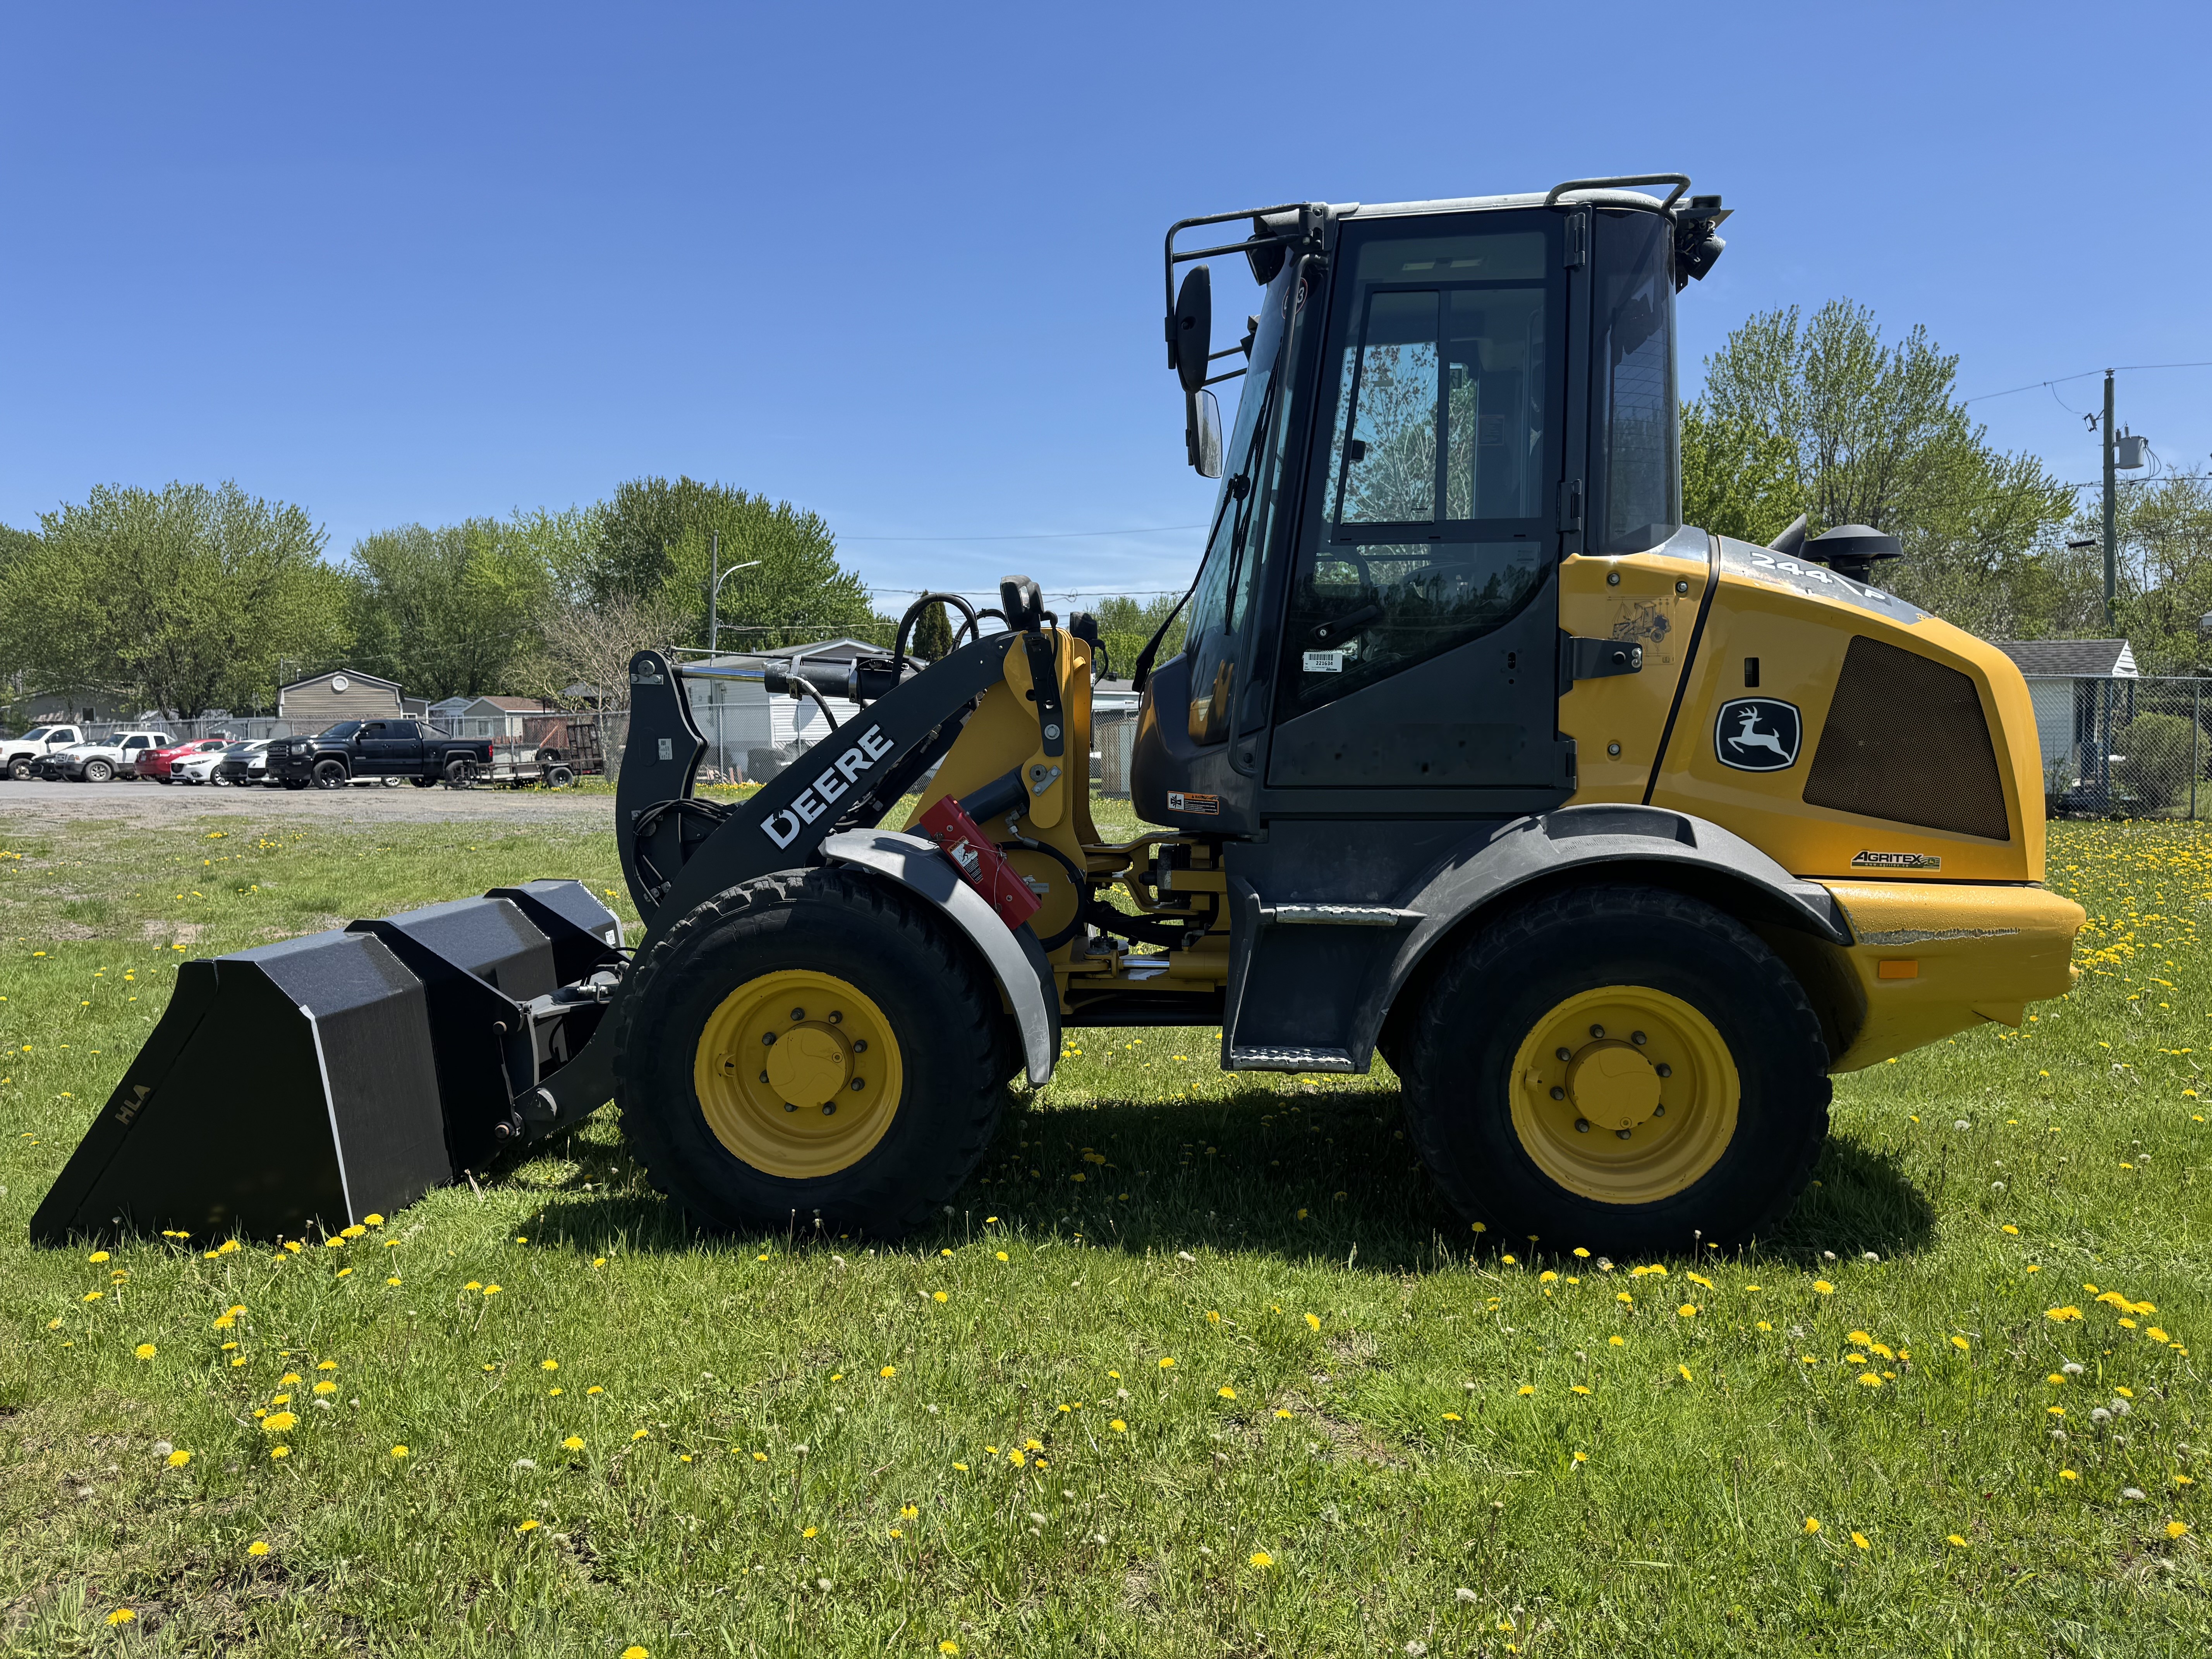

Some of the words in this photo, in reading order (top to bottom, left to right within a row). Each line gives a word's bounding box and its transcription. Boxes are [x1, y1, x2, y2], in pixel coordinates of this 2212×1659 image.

[1752, 552, 1833, 584] 244
[1865, 589, 1886, 600] P
[760, 724, 894, 850] DEERE
[1852, 852, 1922, 864] AGRITEX
[115, 1085, 150, 1125] HLA
